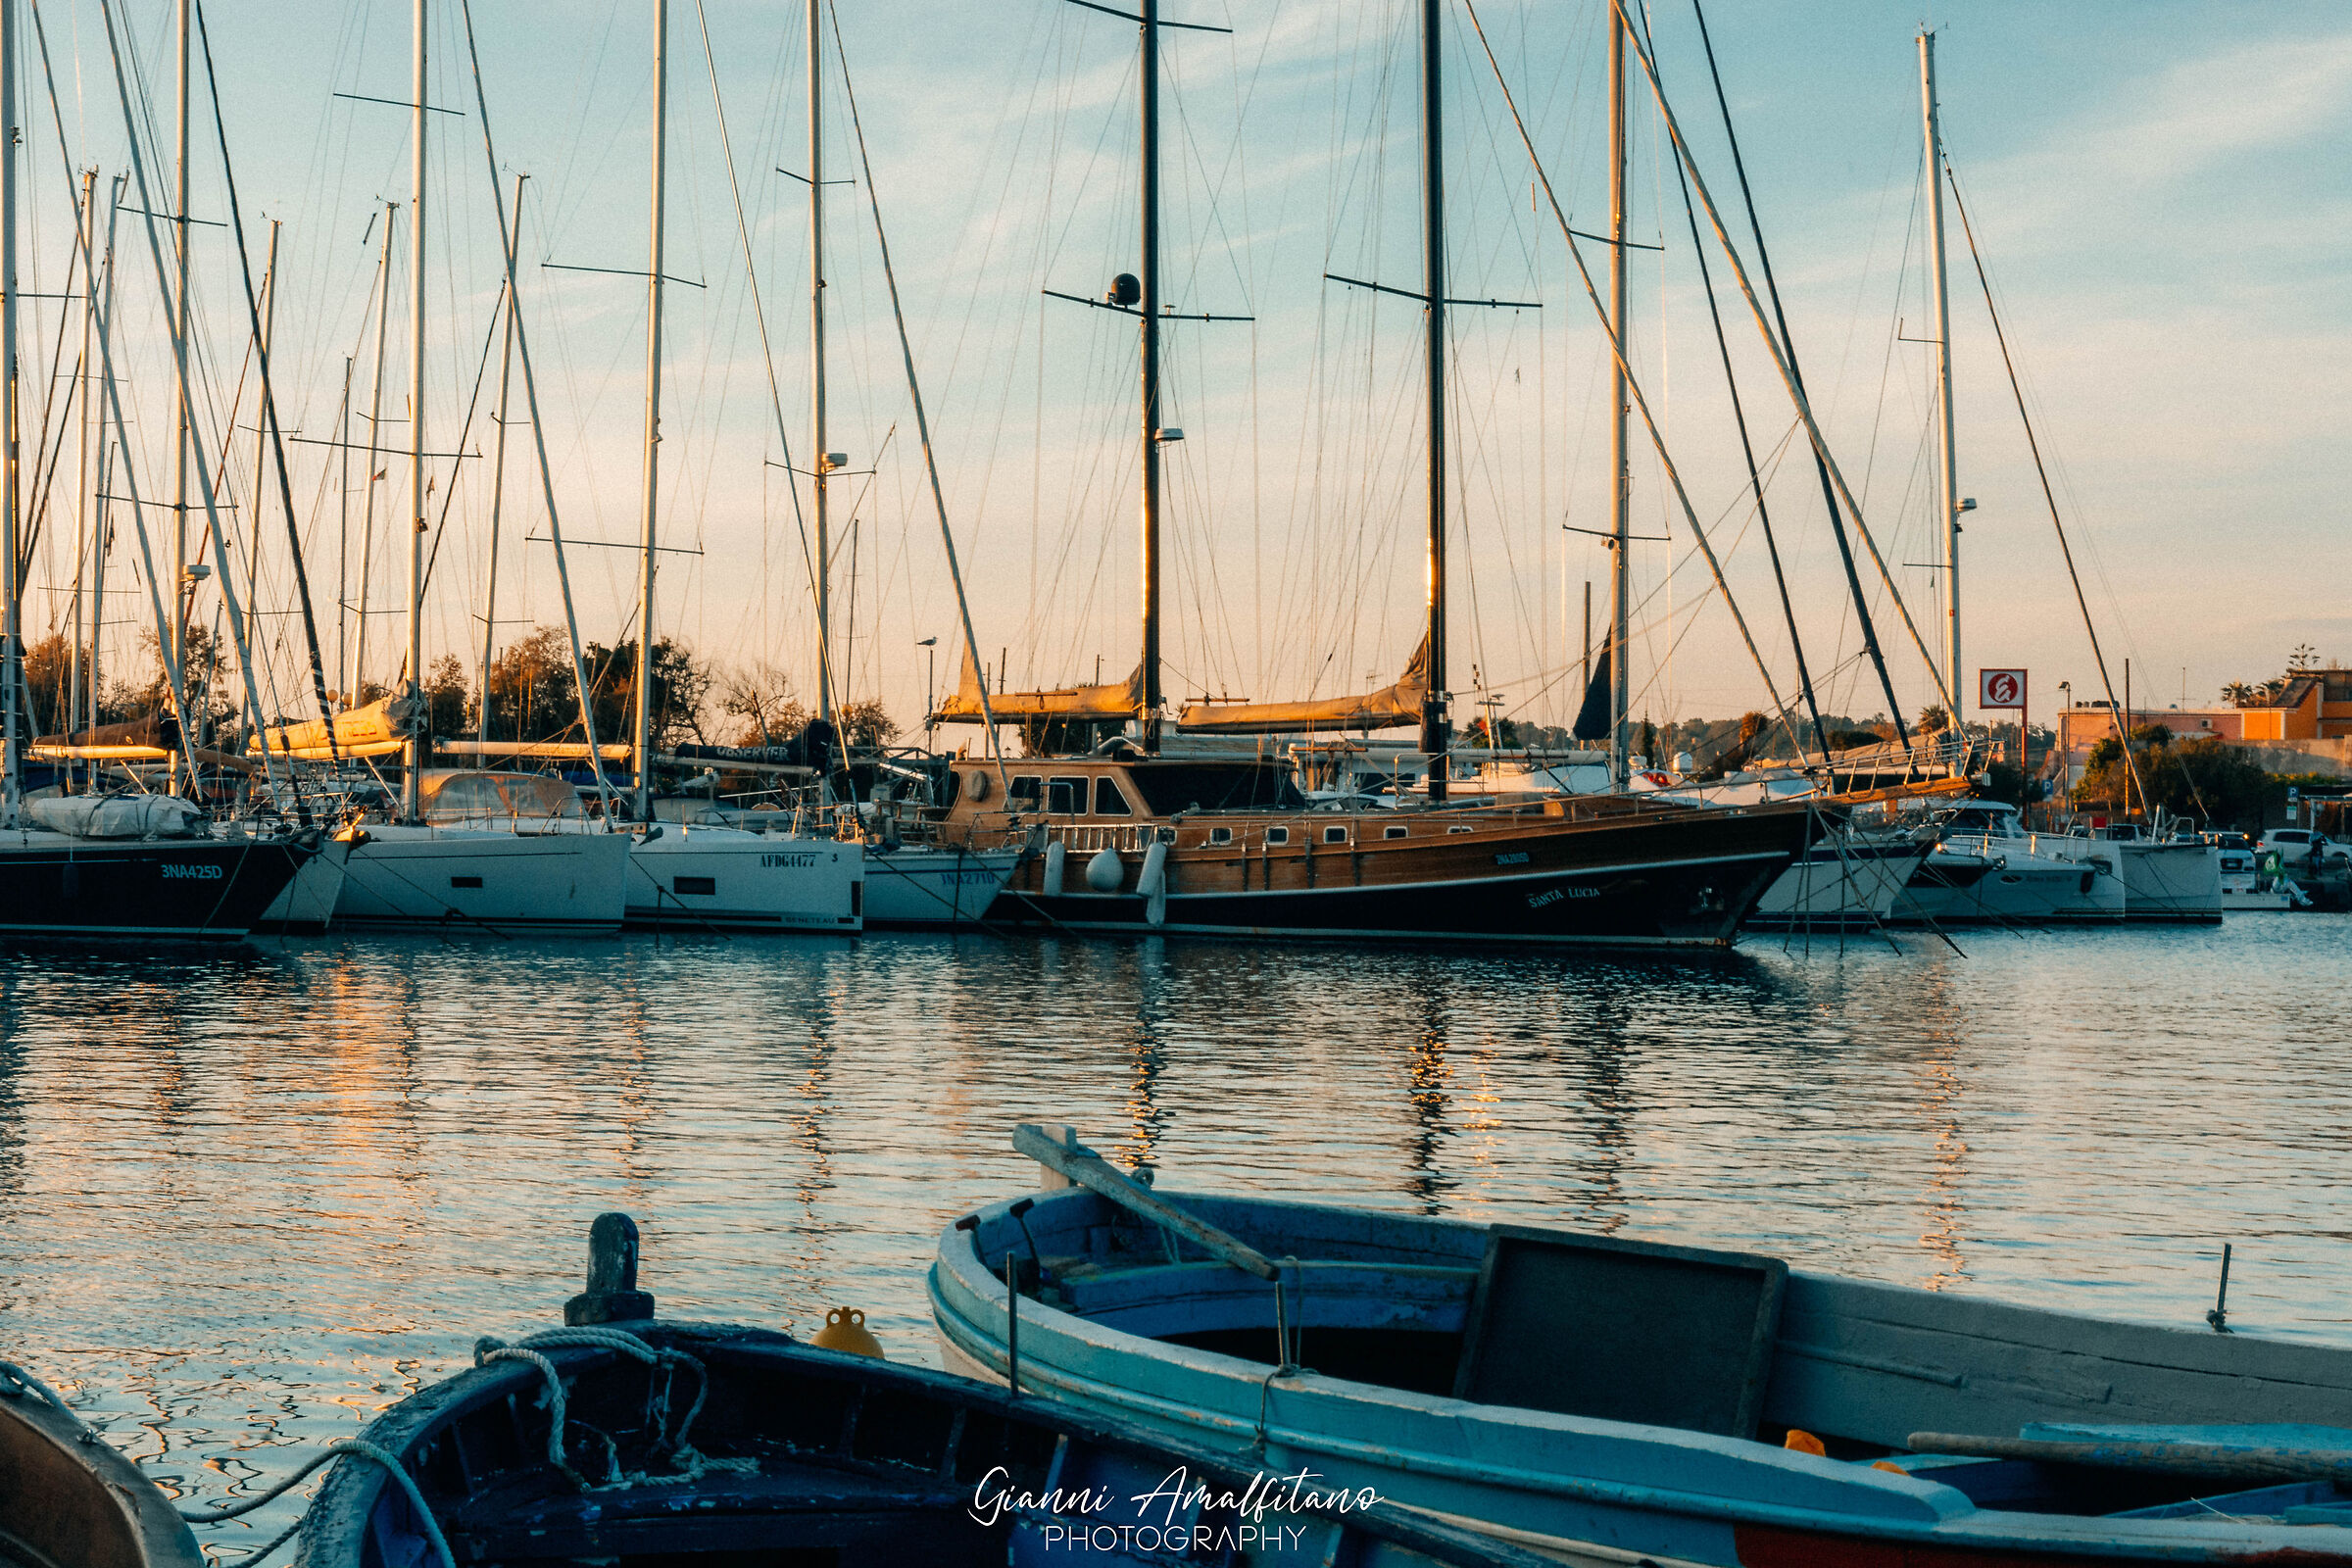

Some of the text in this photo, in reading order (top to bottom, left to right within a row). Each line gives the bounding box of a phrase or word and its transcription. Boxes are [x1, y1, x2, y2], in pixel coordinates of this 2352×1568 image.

[716, 746, 791, 761] OBSERVER
[160, 863, 223, 880] 3NA425D
[1528, 887, 1600, 908] SANTA LUCIA
